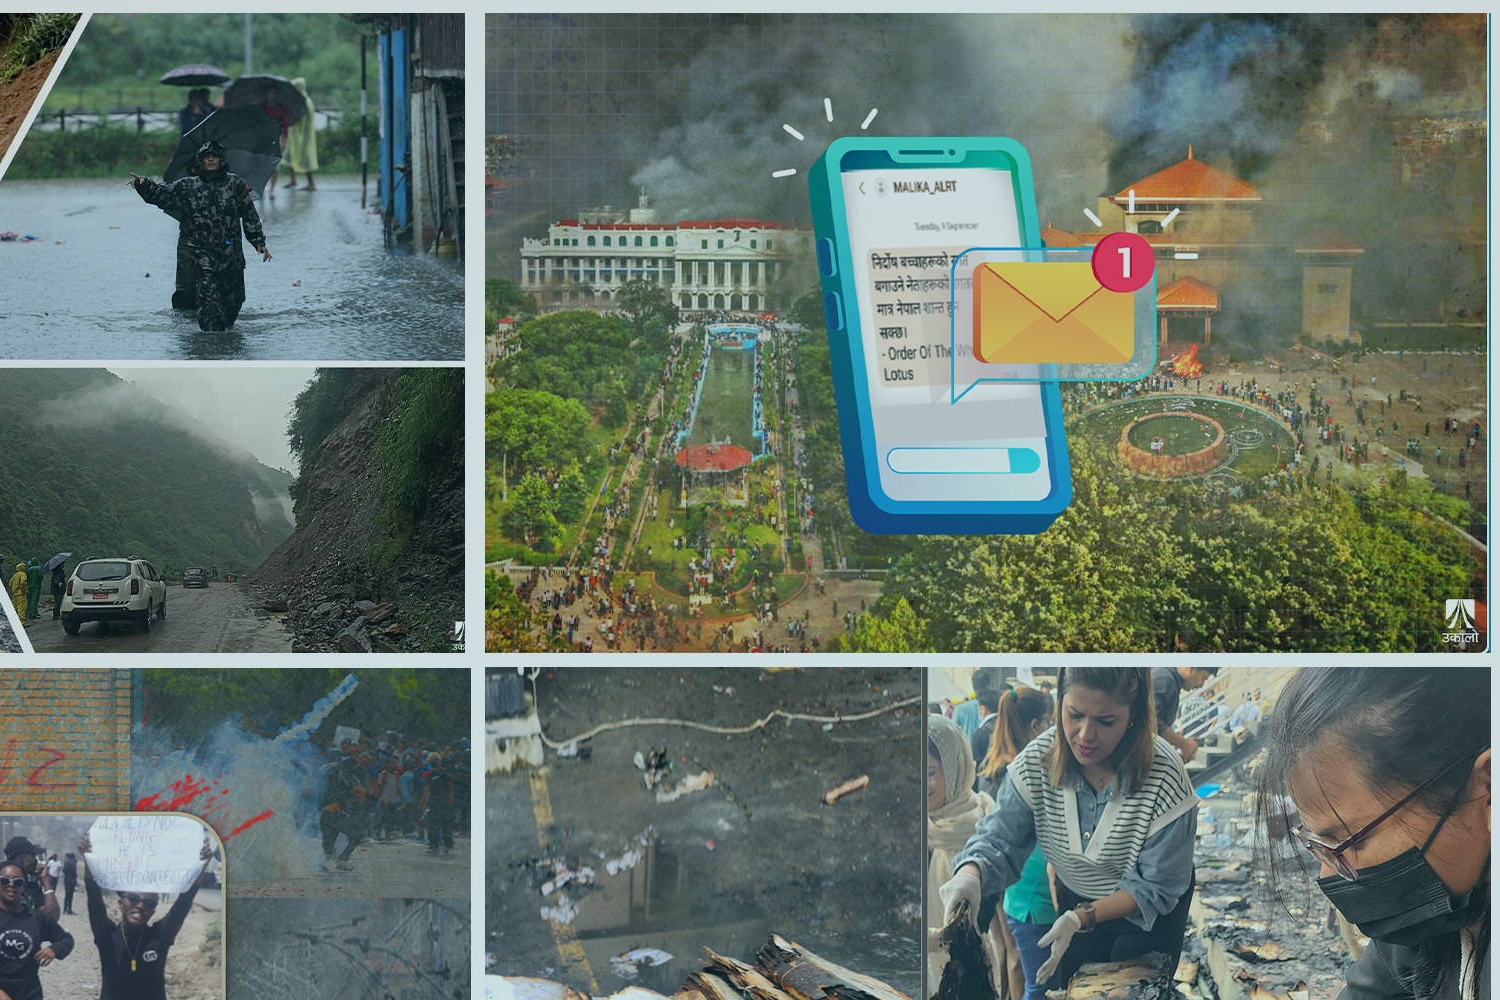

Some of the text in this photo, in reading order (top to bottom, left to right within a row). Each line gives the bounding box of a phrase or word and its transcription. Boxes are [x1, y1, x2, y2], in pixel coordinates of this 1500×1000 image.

[894, 181, 957, 195] MALIKA_ALRT
[1118, 247, 1131, 278] 1
[874, 276, 905, 292] बगाउने
[876, 303, 894, 316] मात्र
[897, 299, 922, 315] नेपाल
[888, 346, 917, 361] Order
[919, 344, 932, 359] Of
[933, 344, 952, 358] The
[883, 367, 914, 381] Lotus
